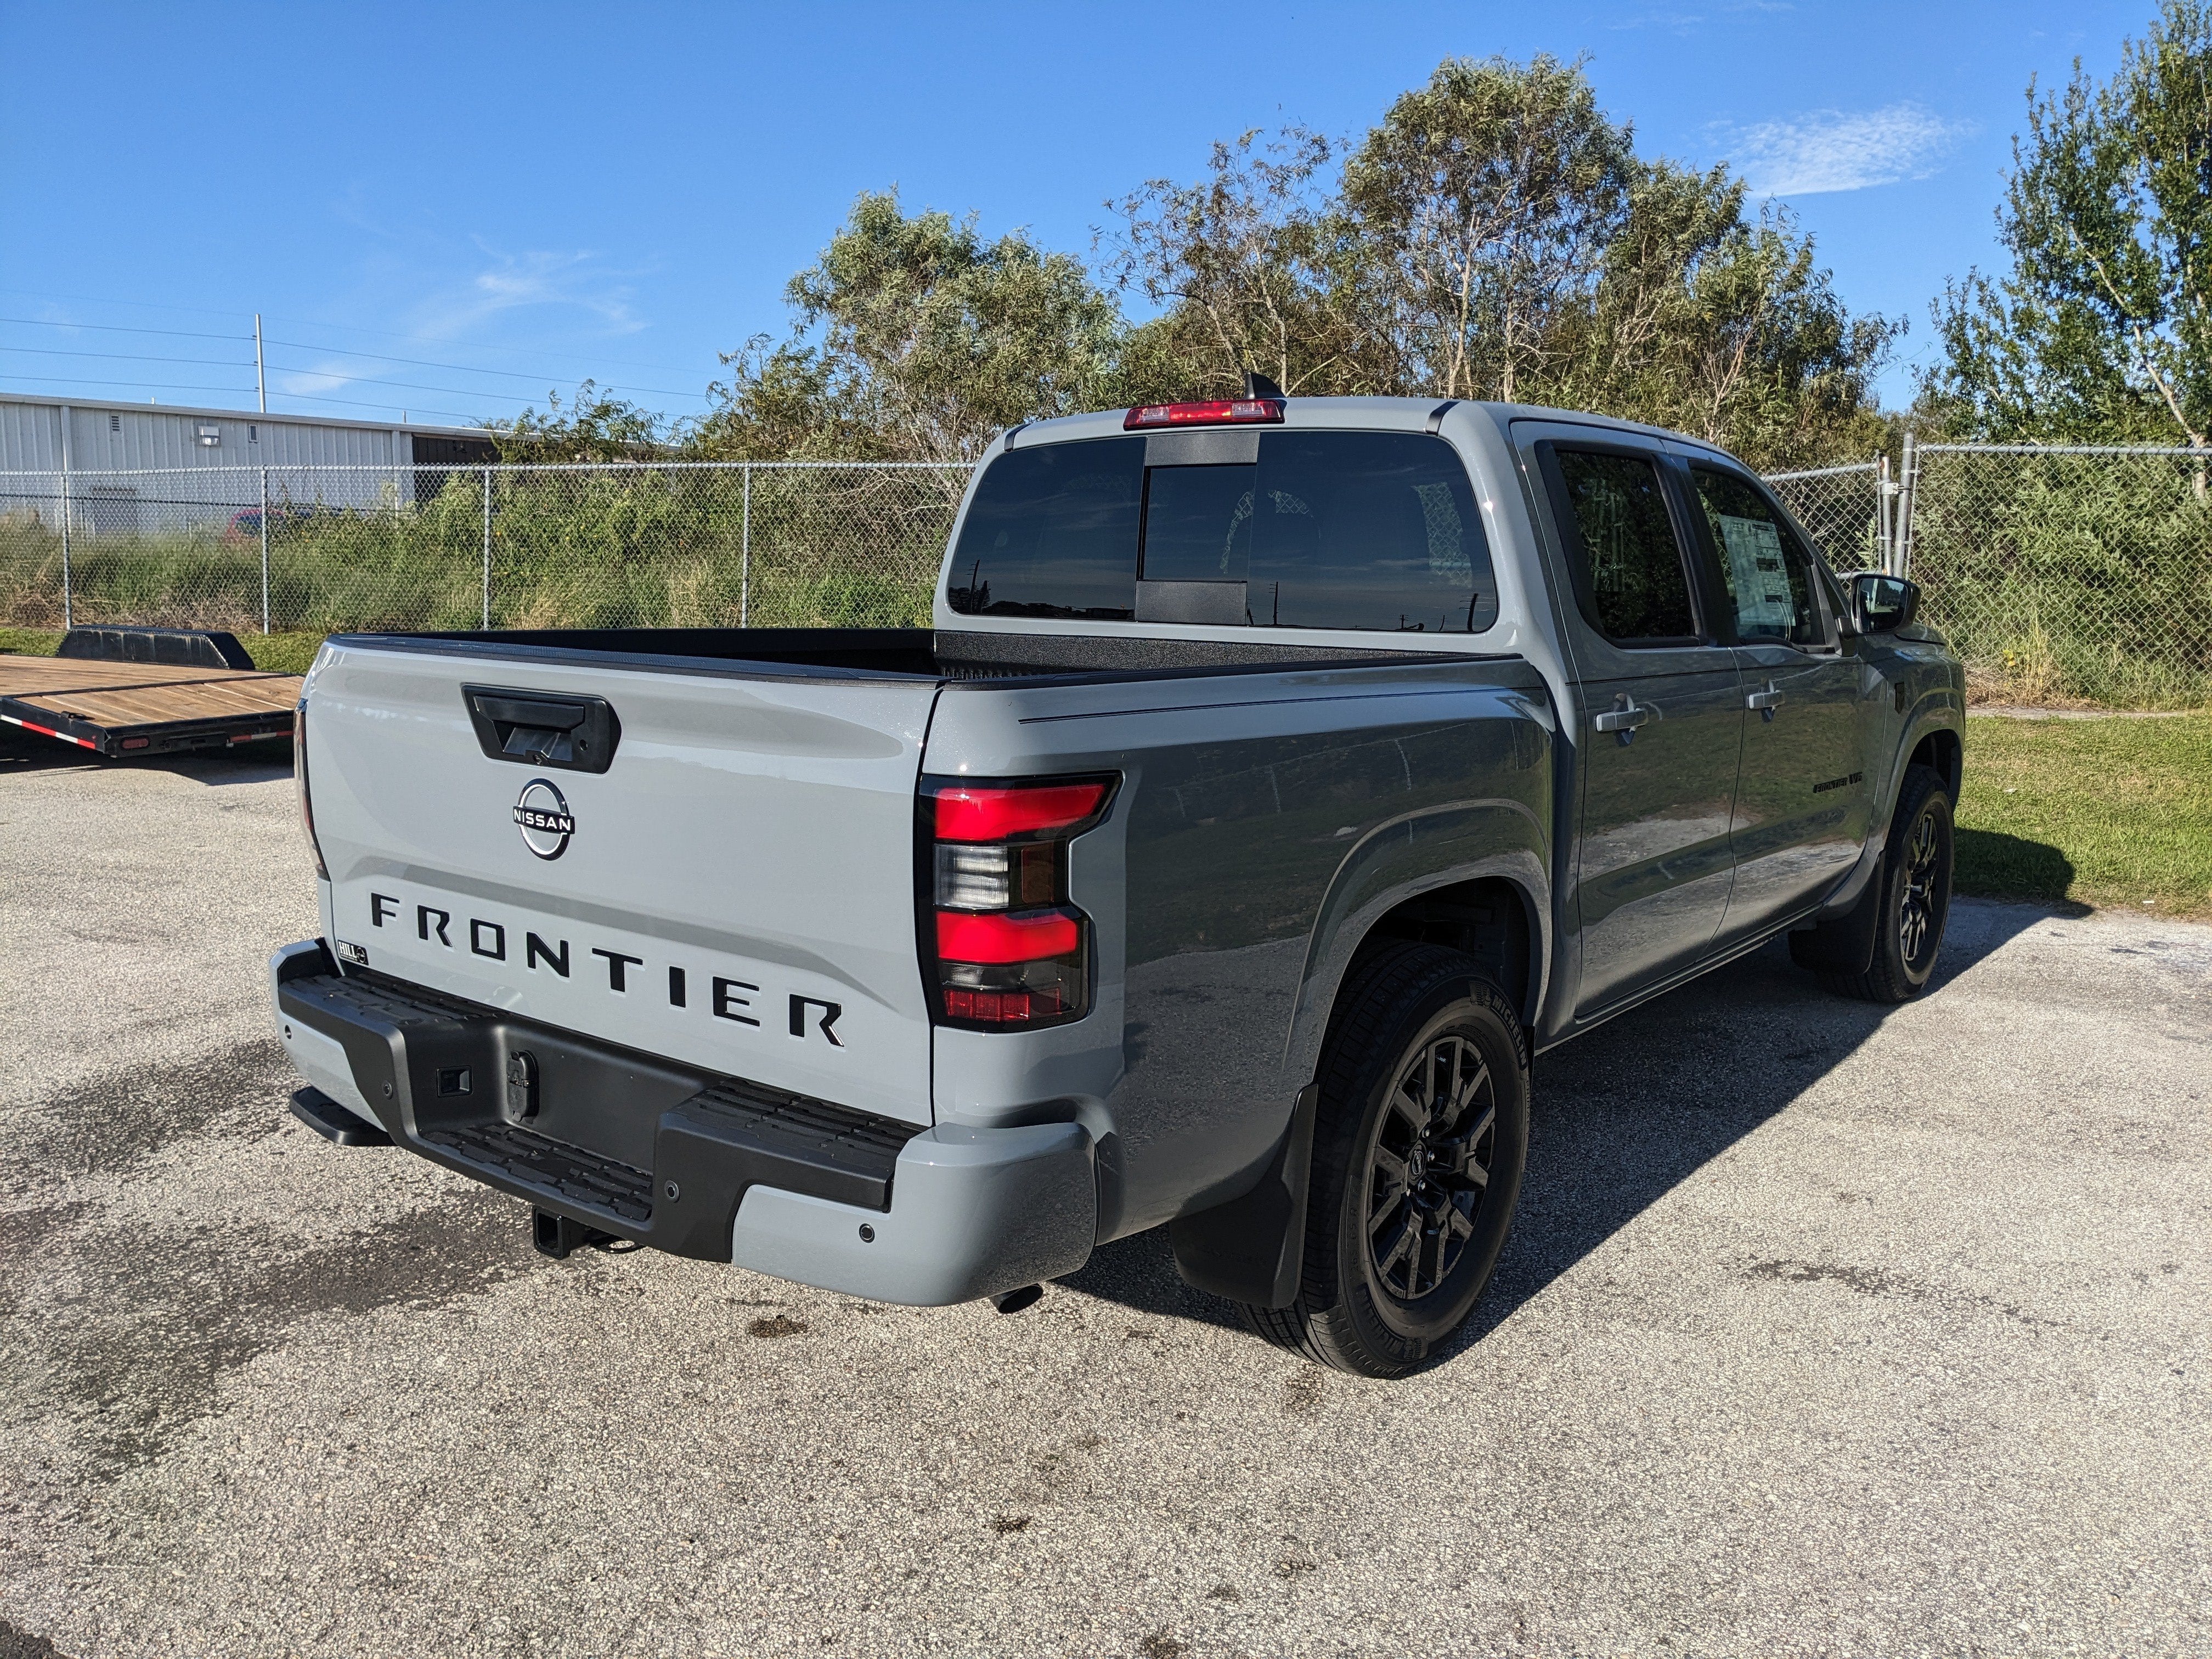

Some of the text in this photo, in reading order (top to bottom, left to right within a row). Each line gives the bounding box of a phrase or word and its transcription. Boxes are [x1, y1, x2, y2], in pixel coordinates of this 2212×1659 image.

[514, 809, 571, 831] NISSAN
[338, 941, 357, 958] HILL
[371, 893, 845, 1047] FRONTIER
[1492, 995, 1527, 1065] MICHELIN
